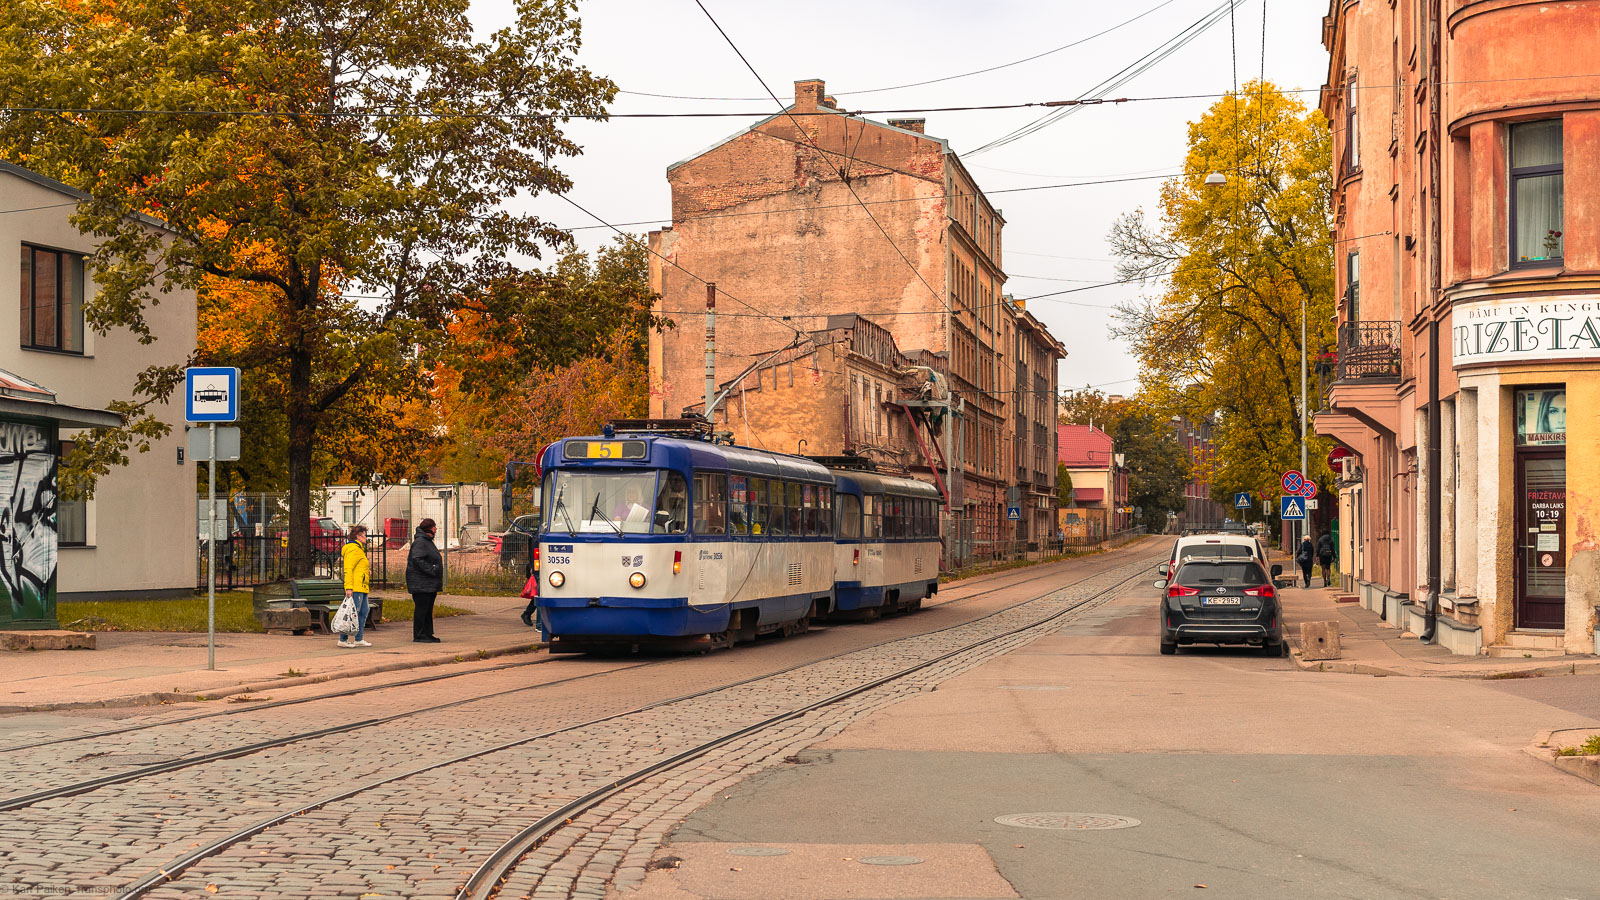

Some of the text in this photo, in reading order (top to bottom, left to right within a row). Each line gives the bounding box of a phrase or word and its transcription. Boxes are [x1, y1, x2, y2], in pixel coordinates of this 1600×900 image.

[1469, 308, 1501, 319] DĀMU
[1509, 306, 1529, 316] UN
[1453, 315, 1600, 358] FRIZĒTA
[600, 442, 611, 459] 5
[1536, 510, 1545, 518] 10
[1550, 510, 1559, 518] 19
[548, 555, 570, 564] 30536
